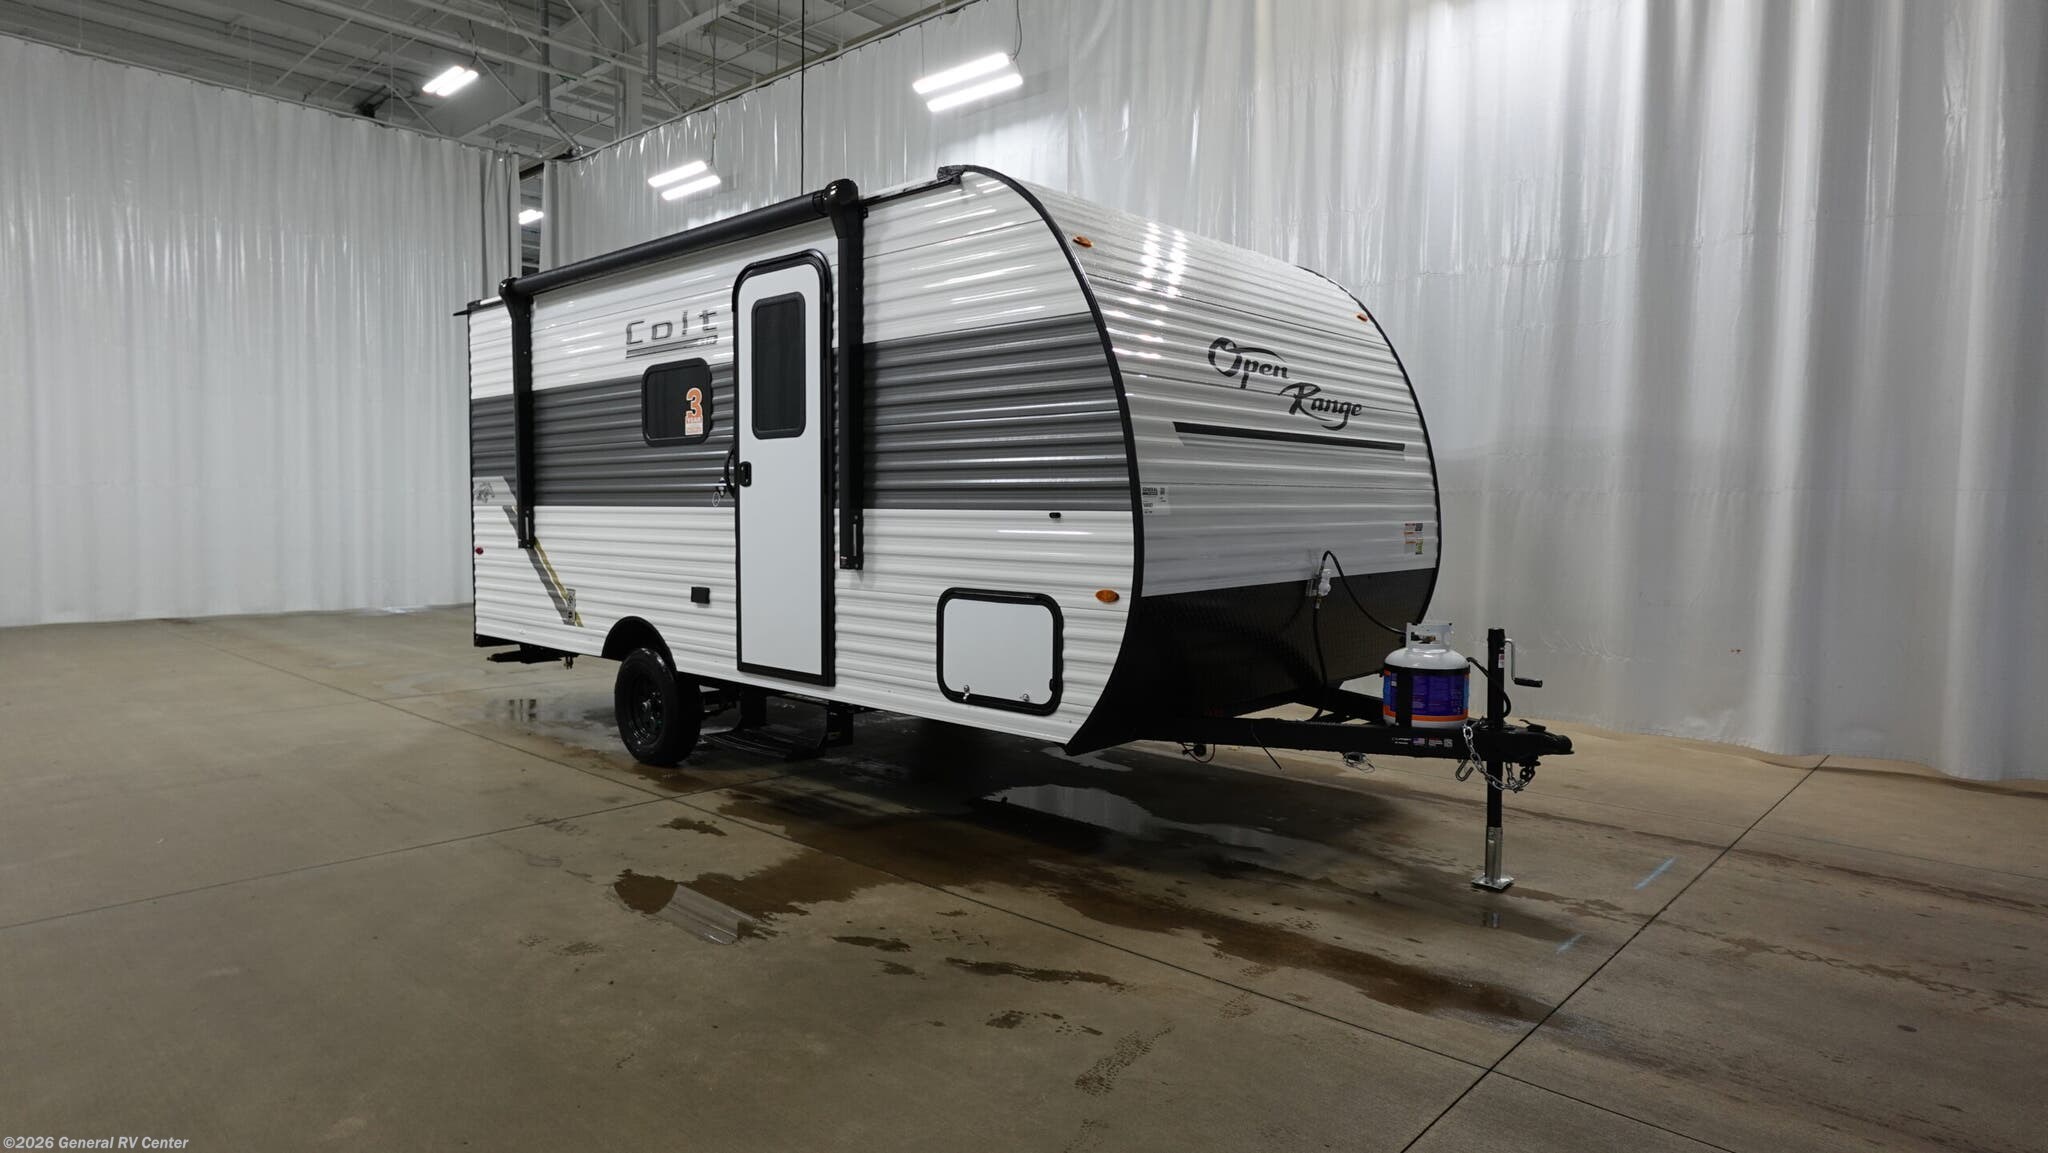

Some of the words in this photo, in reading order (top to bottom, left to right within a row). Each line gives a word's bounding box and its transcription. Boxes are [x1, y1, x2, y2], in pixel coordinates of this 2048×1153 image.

[626, 310, 718, 345] Colt
[1207, 336, 1289, 389] Open
[686, 387, 703, 418] 3
[1278, 382, 1363, 431] Range
